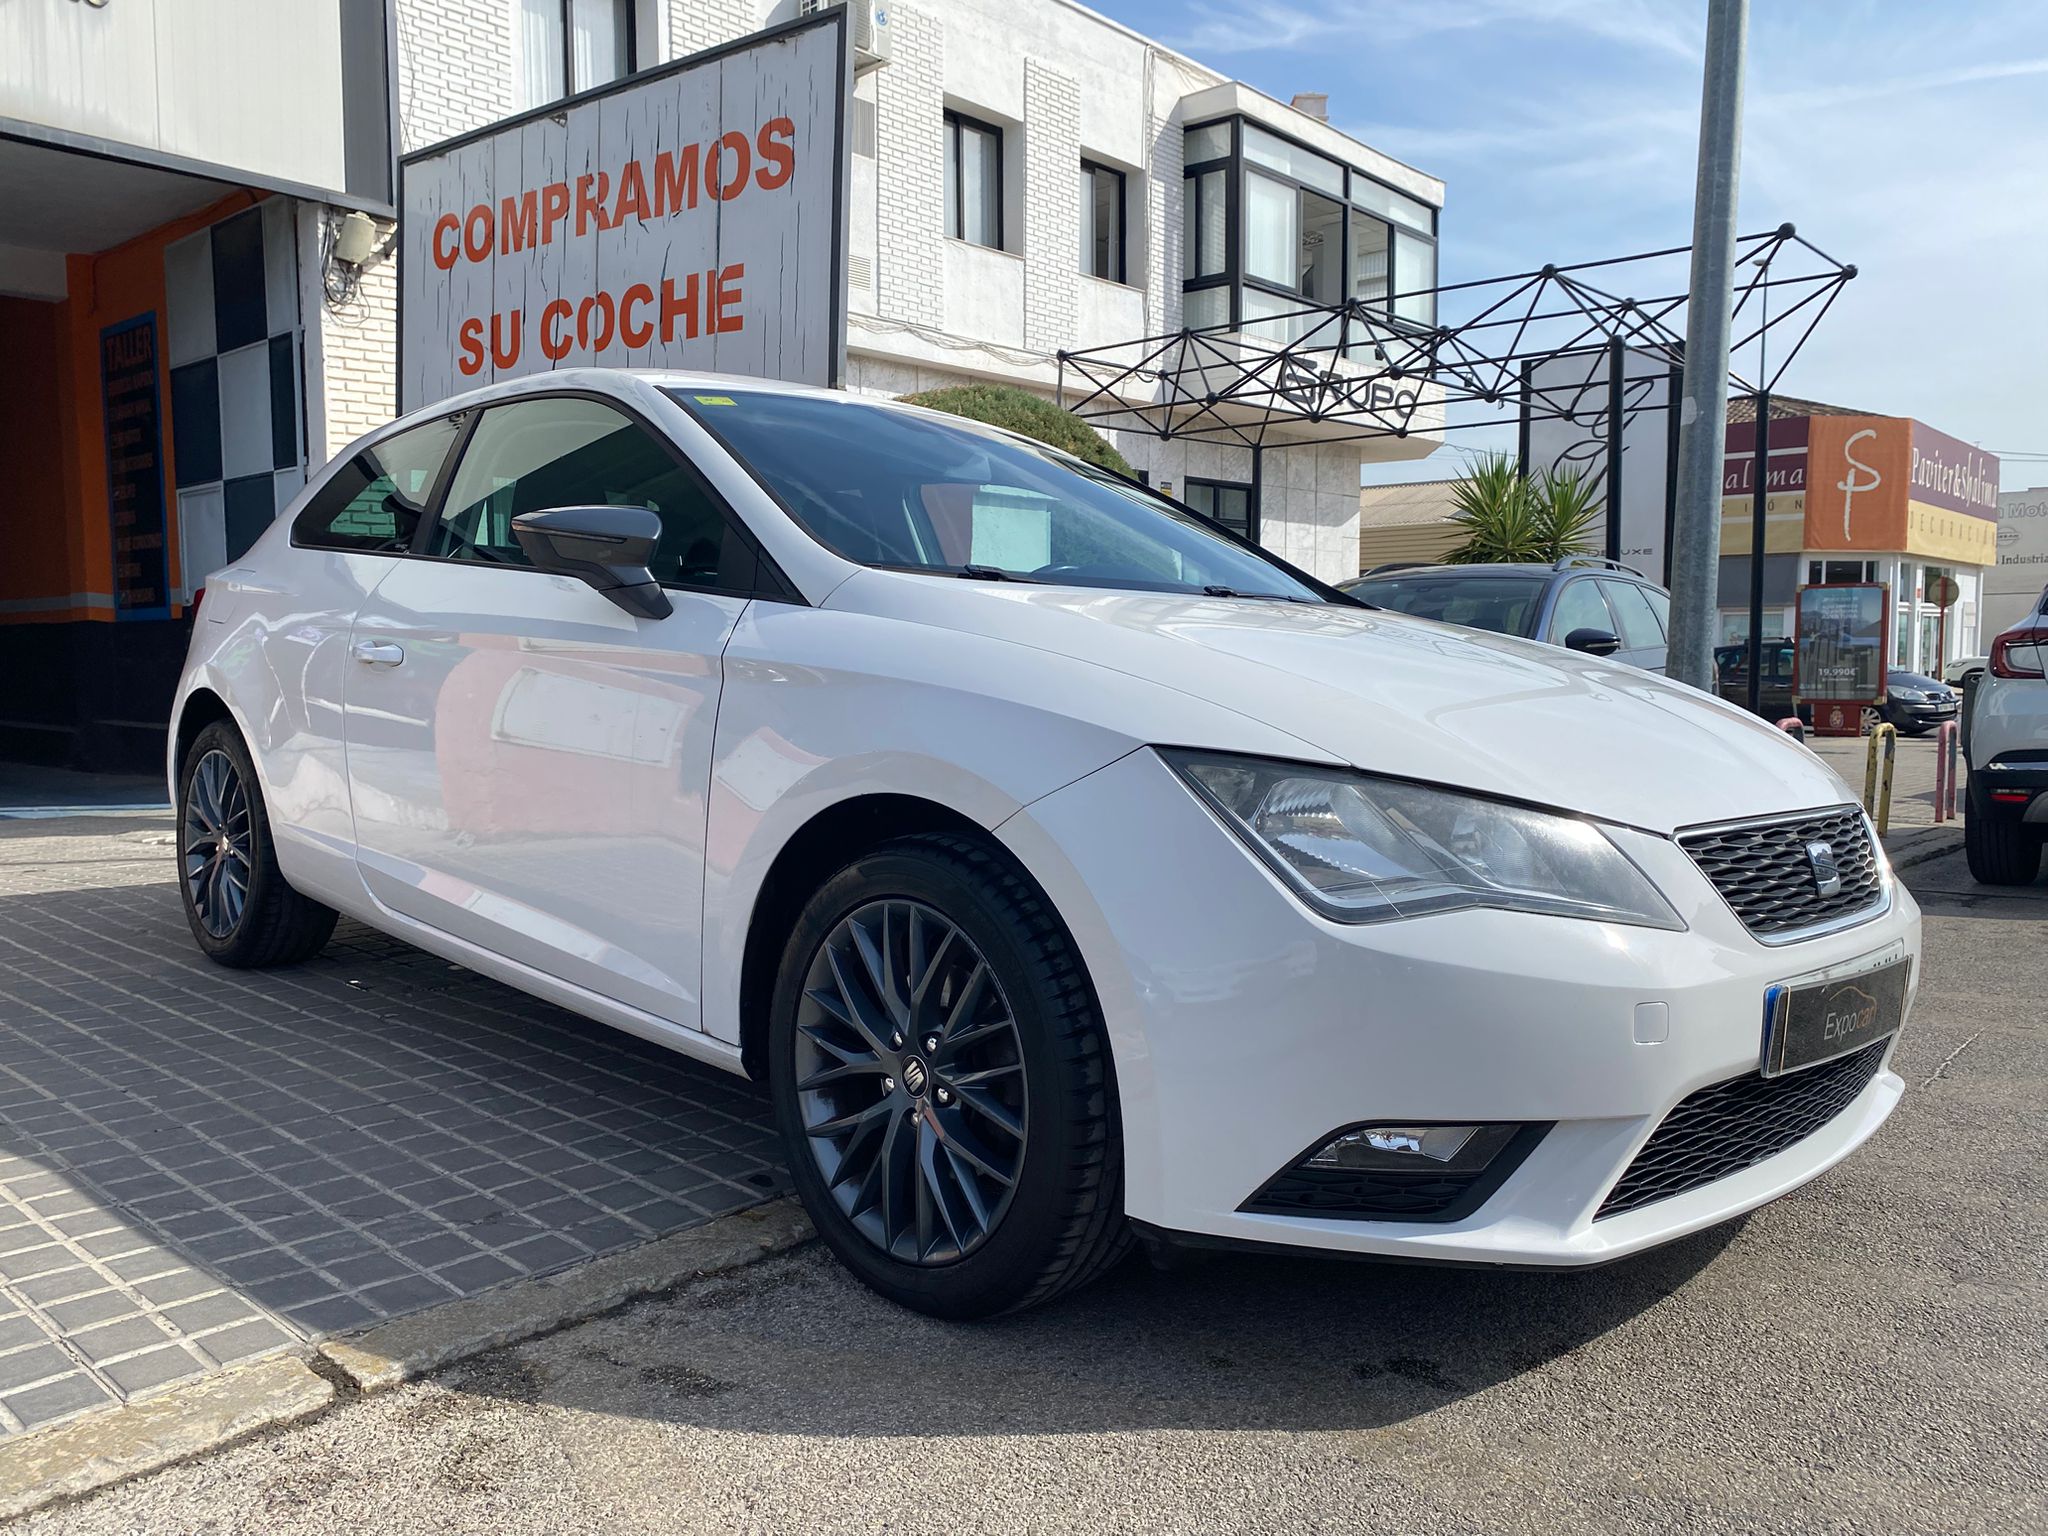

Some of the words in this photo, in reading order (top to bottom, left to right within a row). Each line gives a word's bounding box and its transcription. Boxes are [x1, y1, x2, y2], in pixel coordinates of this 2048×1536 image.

[432, 117, 795, 271] COMPRAMOS
[458, 309, 521, 376] SU
[540, 263, 745, 360] COCHE
[1280, 355, 1417, 419] GRUPO
